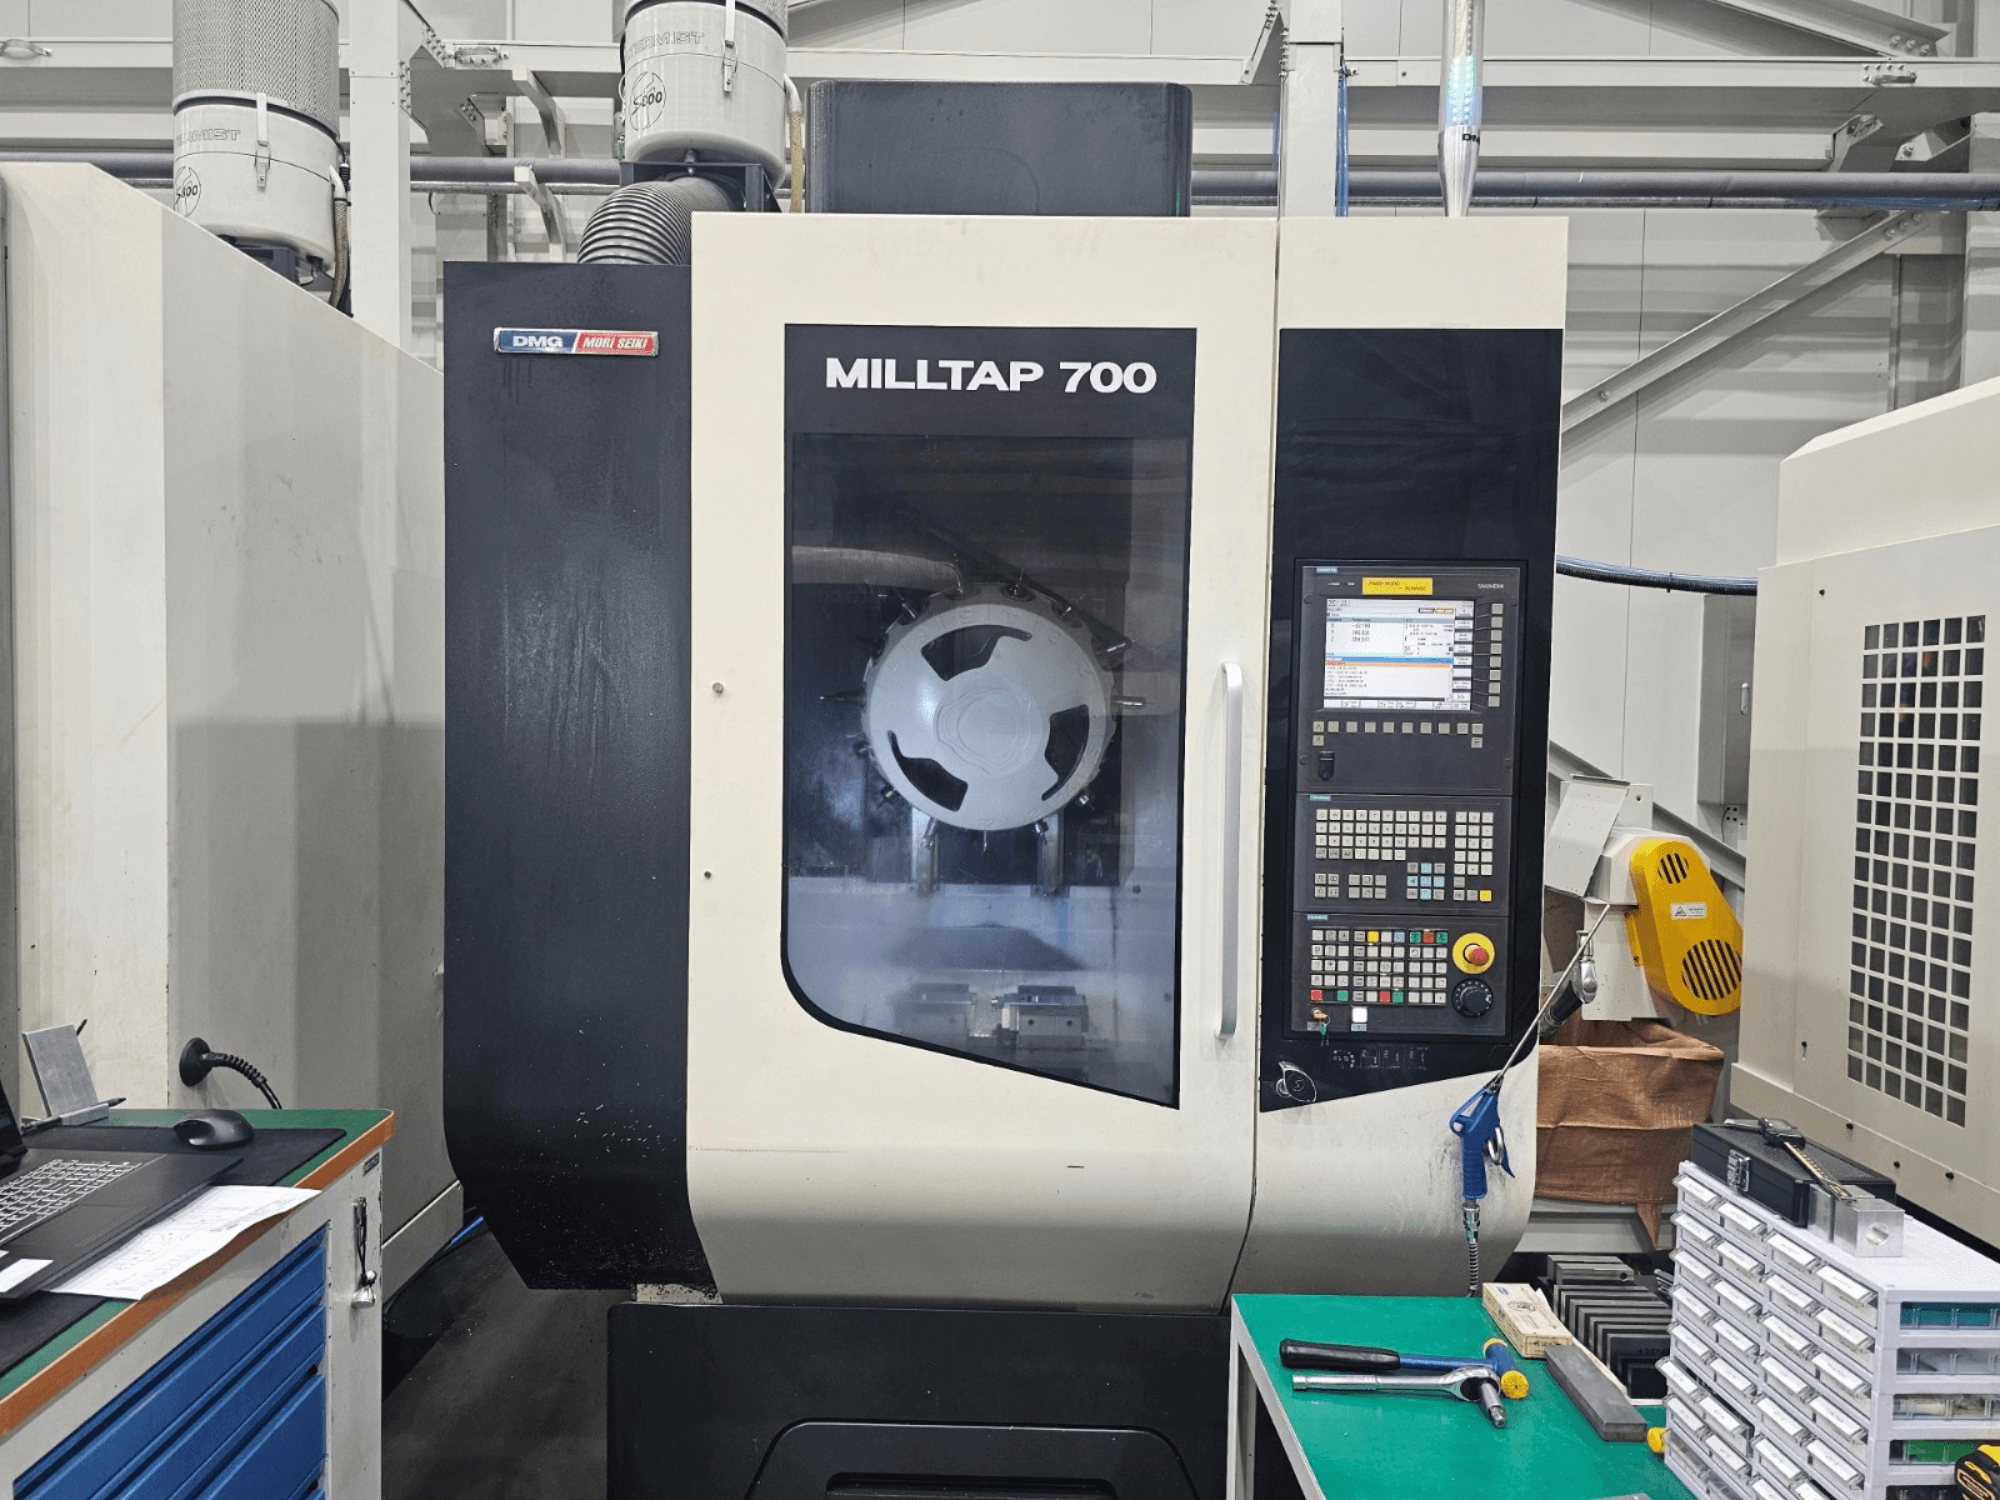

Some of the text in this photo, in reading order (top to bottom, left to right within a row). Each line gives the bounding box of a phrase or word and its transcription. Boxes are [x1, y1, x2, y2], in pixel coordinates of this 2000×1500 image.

[513, 335, 648, 349] DMG MORI SEIKI
[826, 357, 1157, 394] MILLTAP 700
